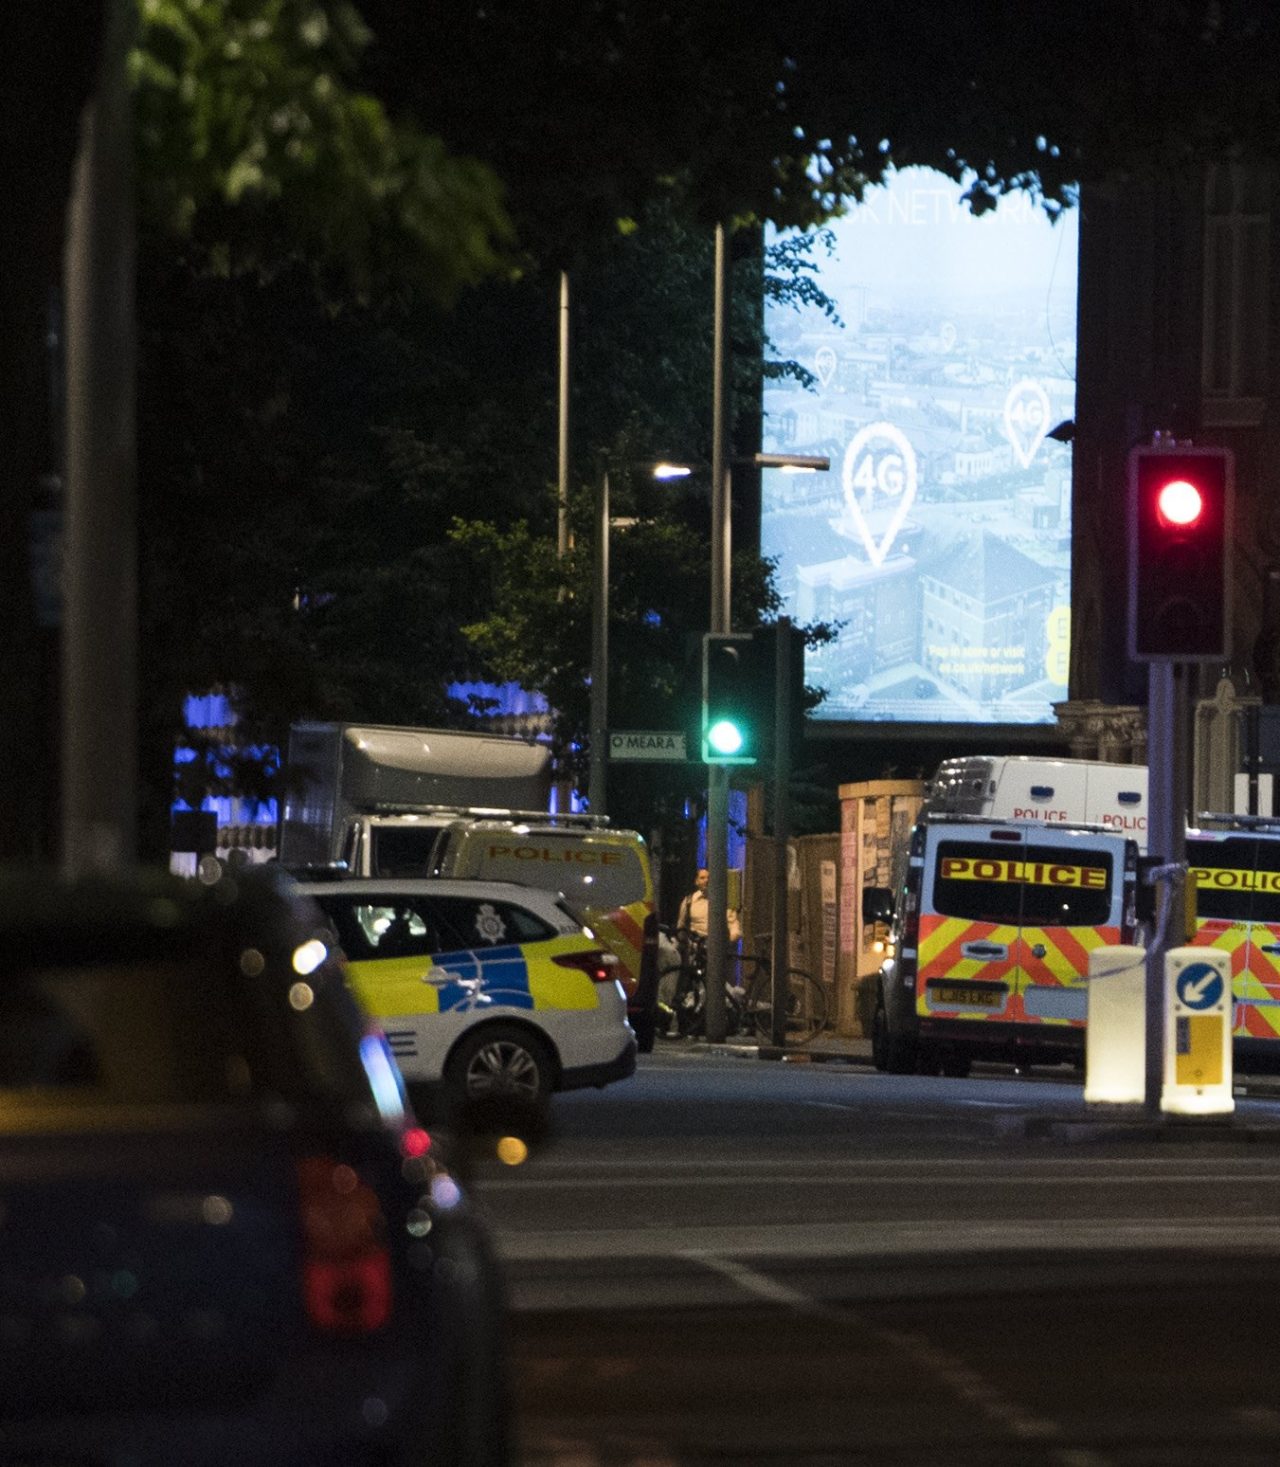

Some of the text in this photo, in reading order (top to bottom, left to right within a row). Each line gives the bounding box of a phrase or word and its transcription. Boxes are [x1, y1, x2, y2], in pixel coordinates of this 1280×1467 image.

[888, 189, 1040, 224] NETWRK
[853, 454, 904, 496] 4G
[1103, 815, 1147, 830] POLIC
[489, 846, 623, 865] POLICE
[942, 858, 1106, 889] POLICE
